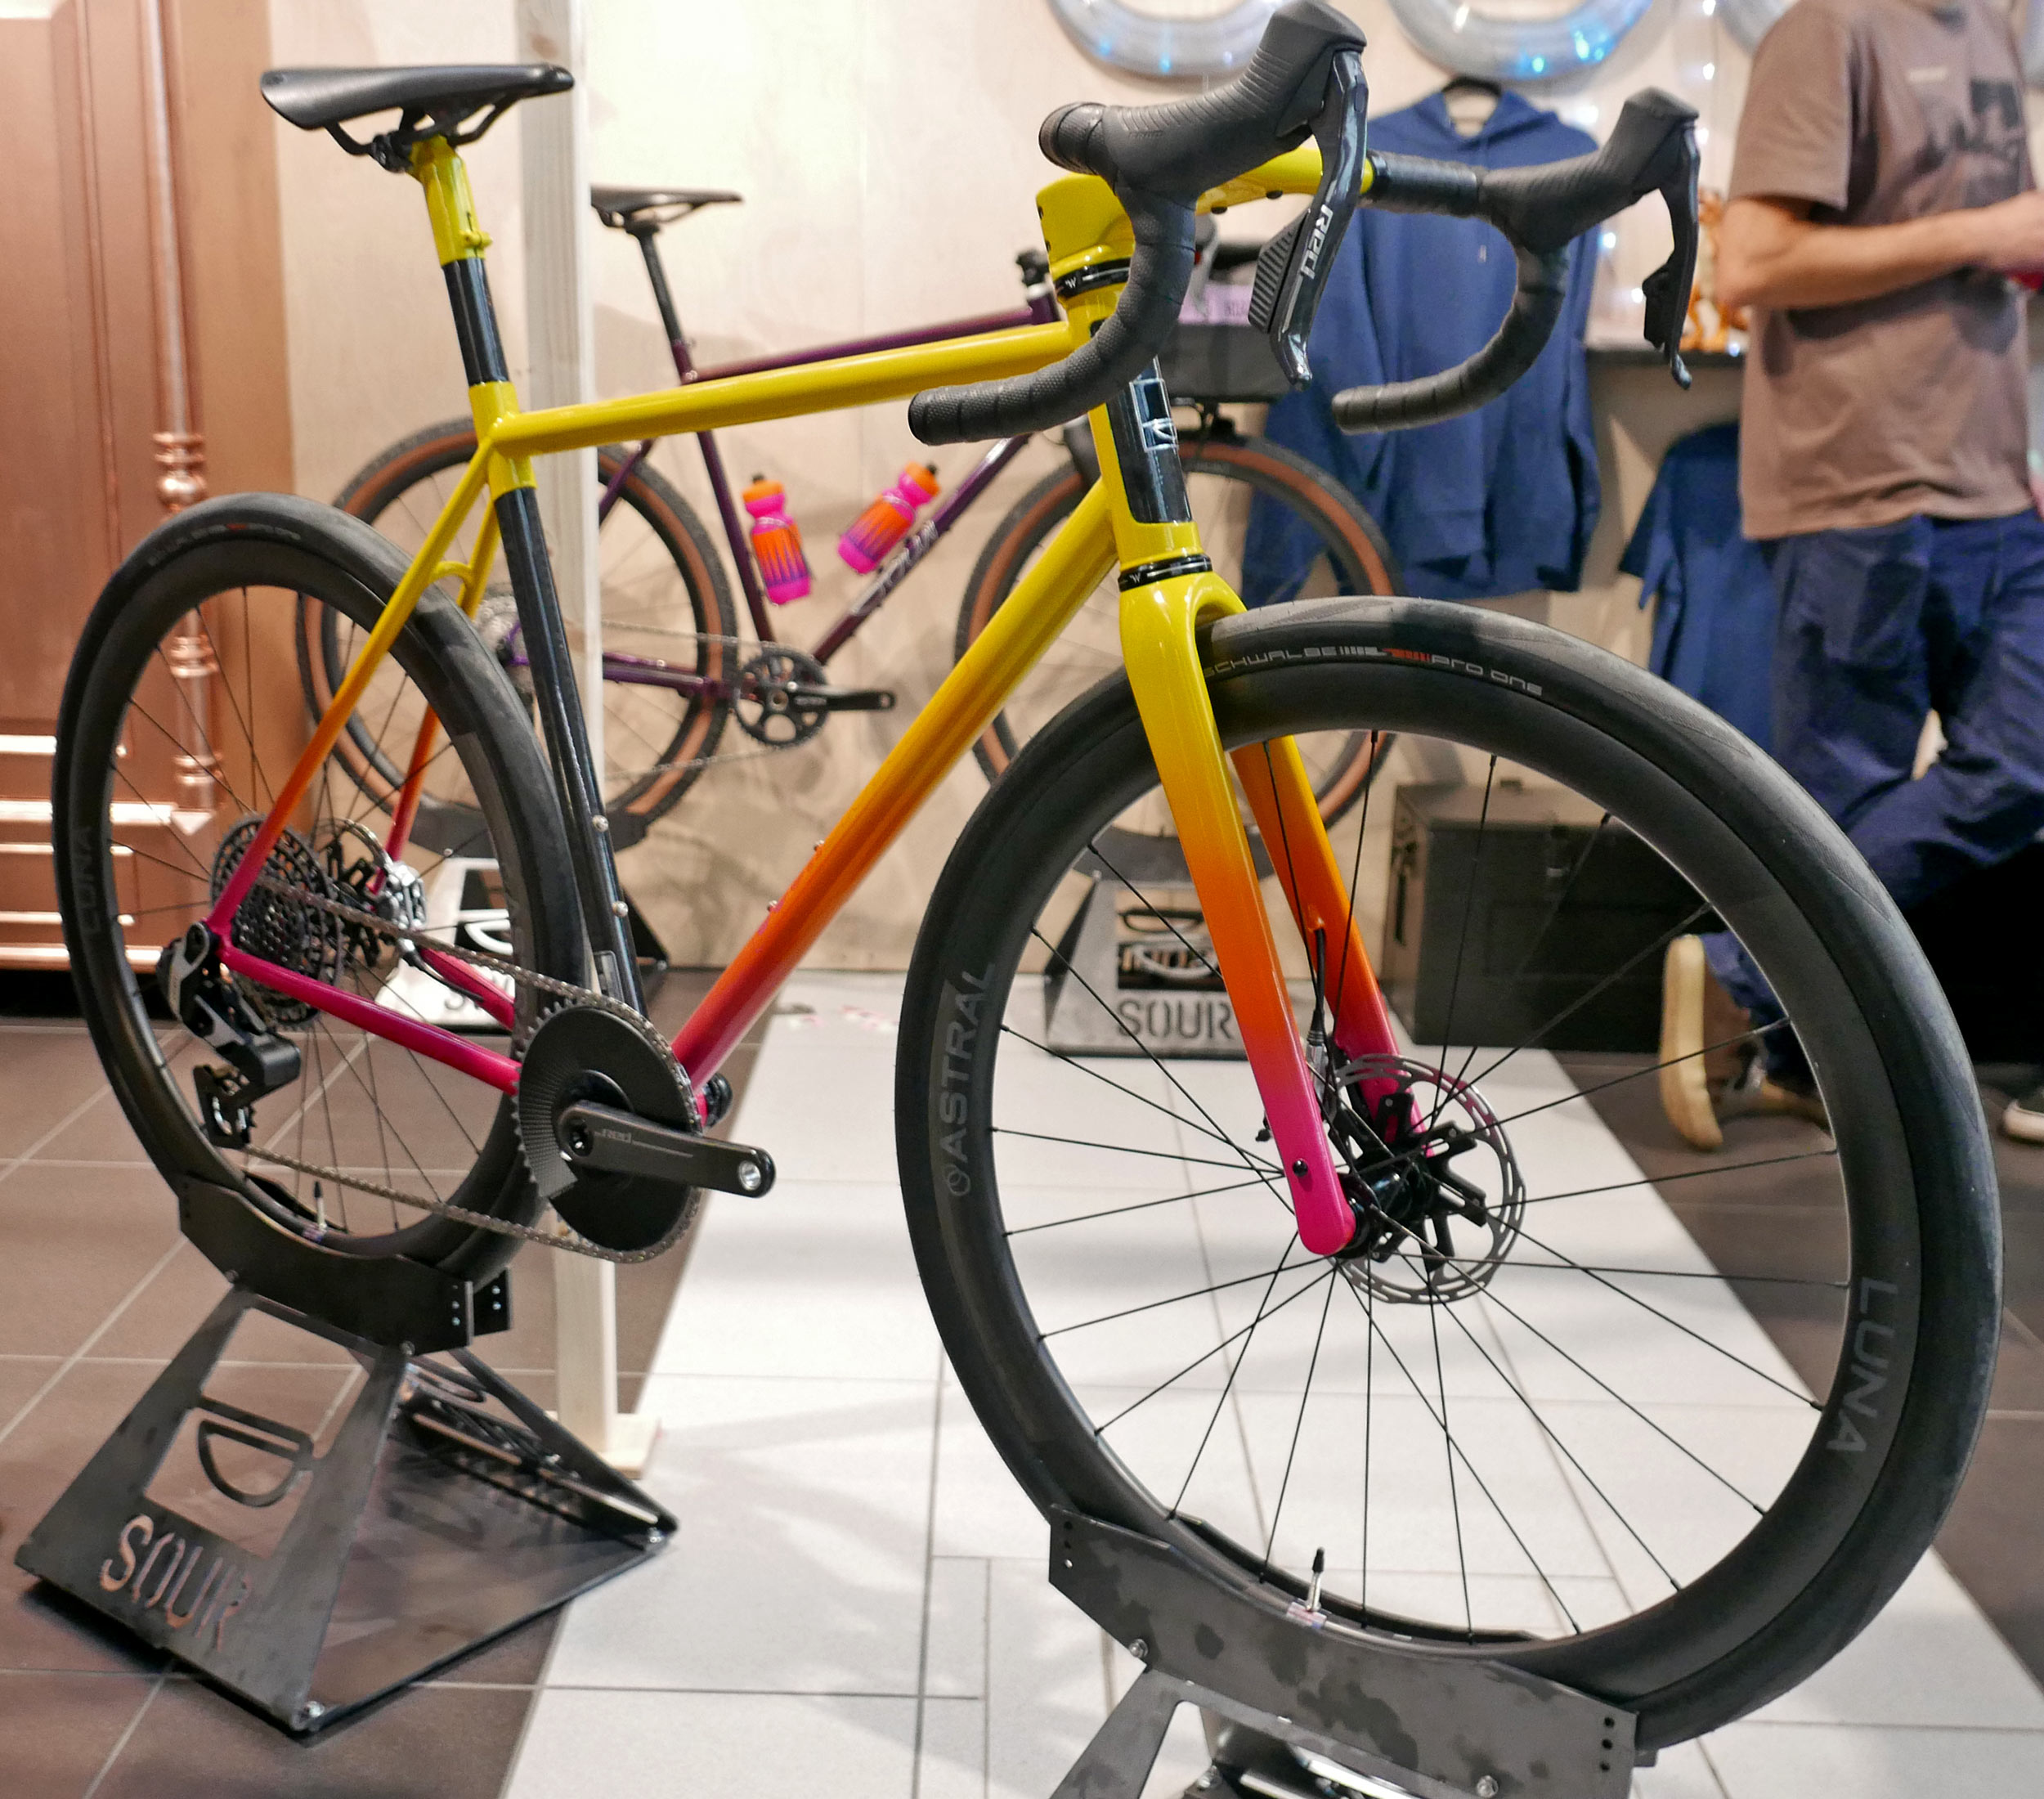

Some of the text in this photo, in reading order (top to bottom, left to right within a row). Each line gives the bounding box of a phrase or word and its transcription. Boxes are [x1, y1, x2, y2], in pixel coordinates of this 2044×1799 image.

[941, 962, 995, 1164] ASTRAL
[1118, 998, 1235, 1039] SOUR
[1826, 1277, 1899, 1451] LUNA
[100, 1514, 253, 1653] SOUR
